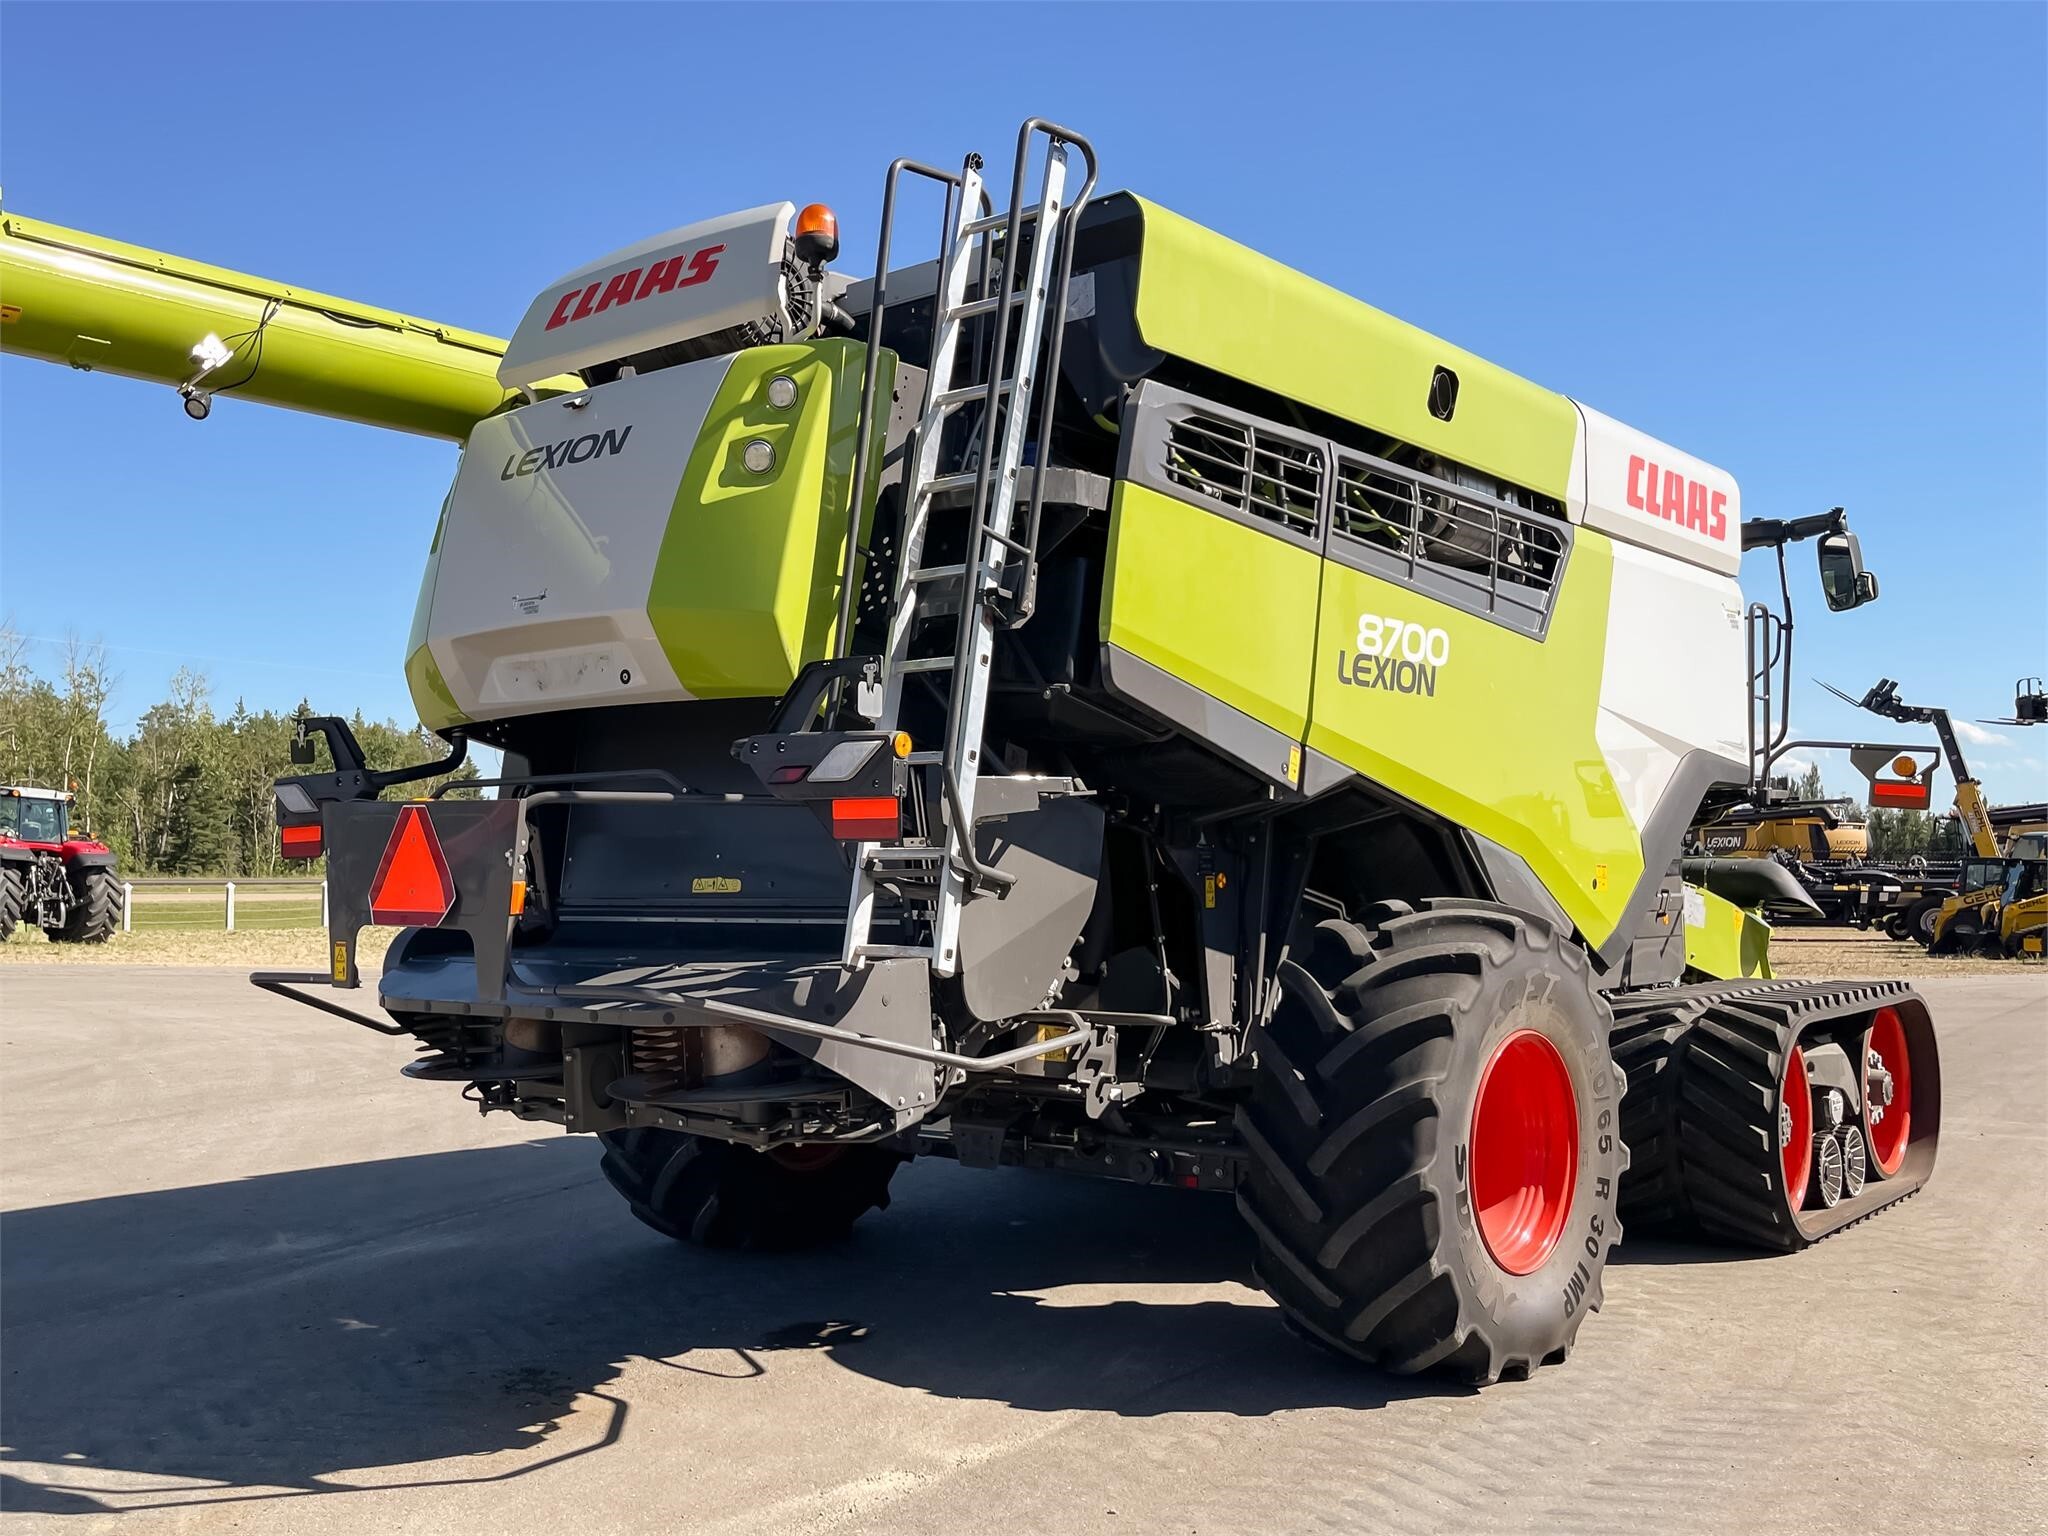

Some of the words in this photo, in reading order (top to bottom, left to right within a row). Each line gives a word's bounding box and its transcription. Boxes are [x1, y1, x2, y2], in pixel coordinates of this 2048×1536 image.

[544, 243, 727, 331] CLAAS
[500, 425, 633, 481] LEXION
[1626, 454, 1727, 541] CLAAS
[1356, 613, 1450, 667] 8700
[1337, 650, 1437, 697] LEXION
[1971, 801, 1987, 833] GEHL
[1706, 835, 1741, 848] LEXION
[2017, 898, 2045, 910] GEHL
[1594, 1176, 1611, 1201] R
[1585, 1214, 1605, 1259] 30
[1562, 1260, 1592, 1320] IMP
